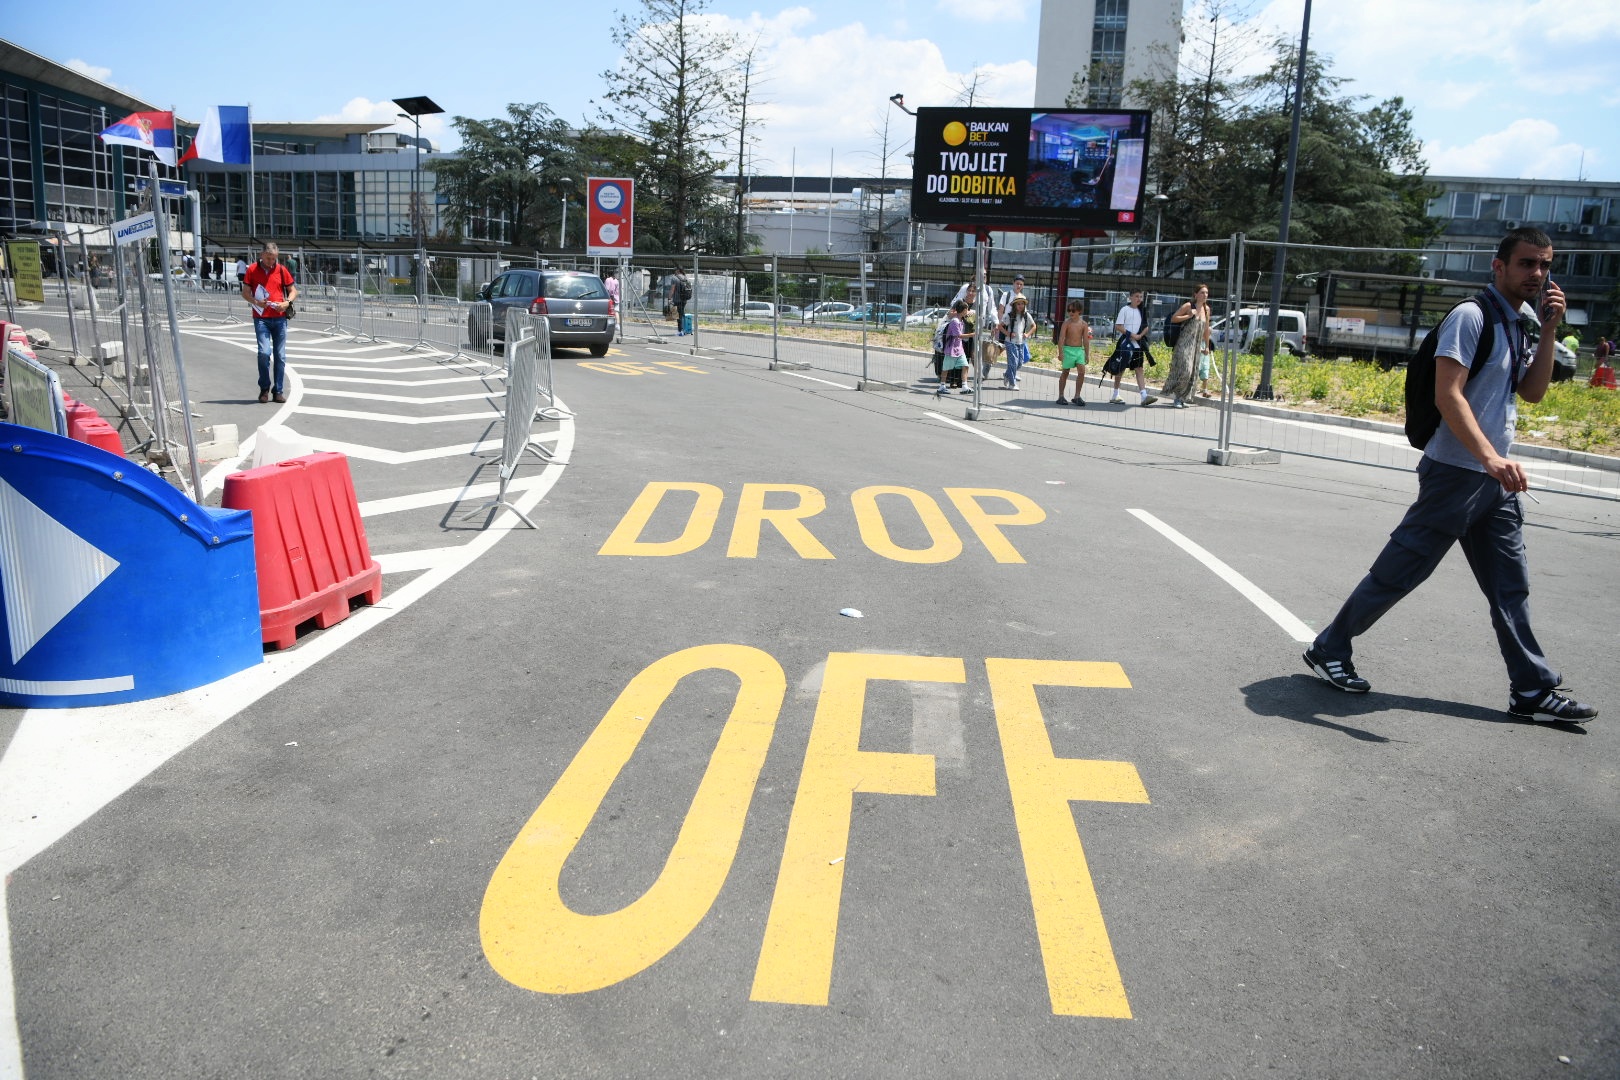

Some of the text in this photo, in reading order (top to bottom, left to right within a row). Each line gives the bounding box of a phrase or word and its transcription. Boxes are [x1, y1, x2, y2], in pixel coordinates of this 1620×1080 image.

[969, 131, 988, 142] BET
[970, 121, 1009, 132] BALKAN
[940, 151, 1008, 173] TVOJ LET
[926, 174, 1016, 195] DO DOBITKA
[576, 361, 711, 376] OFF
[597, 481, 1047, 563] DROP
[479, 643, 1151, 1019] OFF
